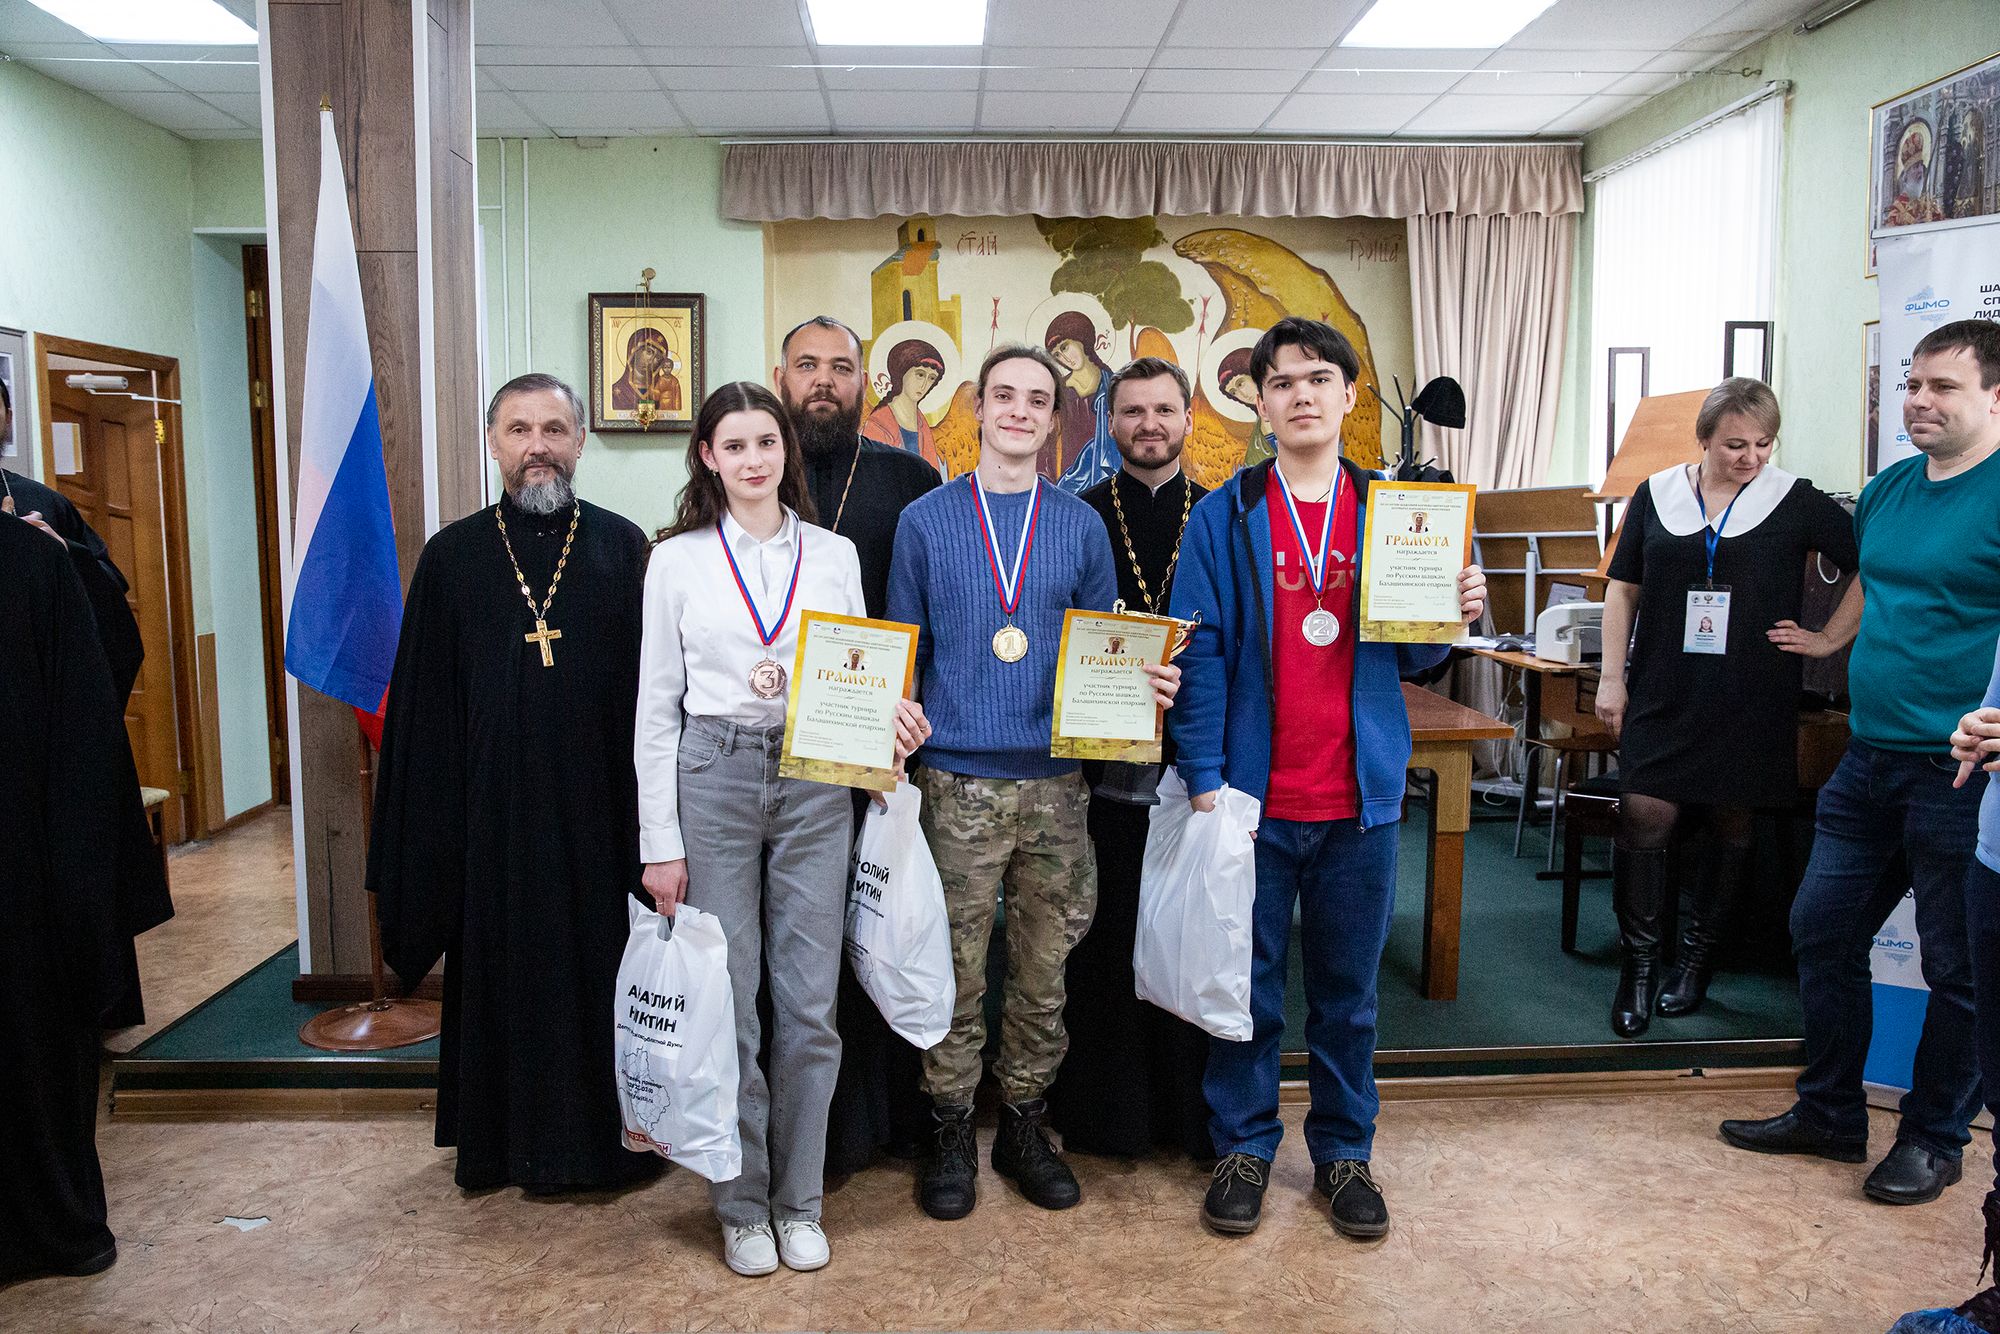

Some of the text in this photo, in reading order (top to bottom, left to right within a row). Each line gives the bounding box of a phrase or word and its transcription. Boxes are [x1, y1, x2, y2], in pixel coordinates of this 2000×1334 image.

[1904, 299, 1950, 311] ФШМО
[1384, 535, 1450, 547] ГРАМОТА
[1396, 548, 1438, 556] награждается
[1276, 549, 1356, 592] UG
[1389, 564, 1443, 573] участник турнира
[1395, 572, 1420, 580] Русским
[1379, 579, 1426, 588] Балашихинской
[1312, 617, 1330, 637] 2
[1004, 635, 1017, 654] 1
[1080, 655, 1145, 667] ГРАМОТА
[1090, 668, 1133, 676] награждается
[760, 670, 776, 689] 3
[817, 668, 888, 689] ГРАМОТА
[828, 685, 874, 697] награждается
[1083, 682, 1137, 691] участник турнира
[1088, 690, 1114, 699] Русским
[819, 701, 878, 714] участник турнира
[1072, 697, 1146, 708] Балашихинской епархии
[814, 709, 880, 723] по Русским шашкам
[806, 714, 886, 733] Балашихинской епархии
